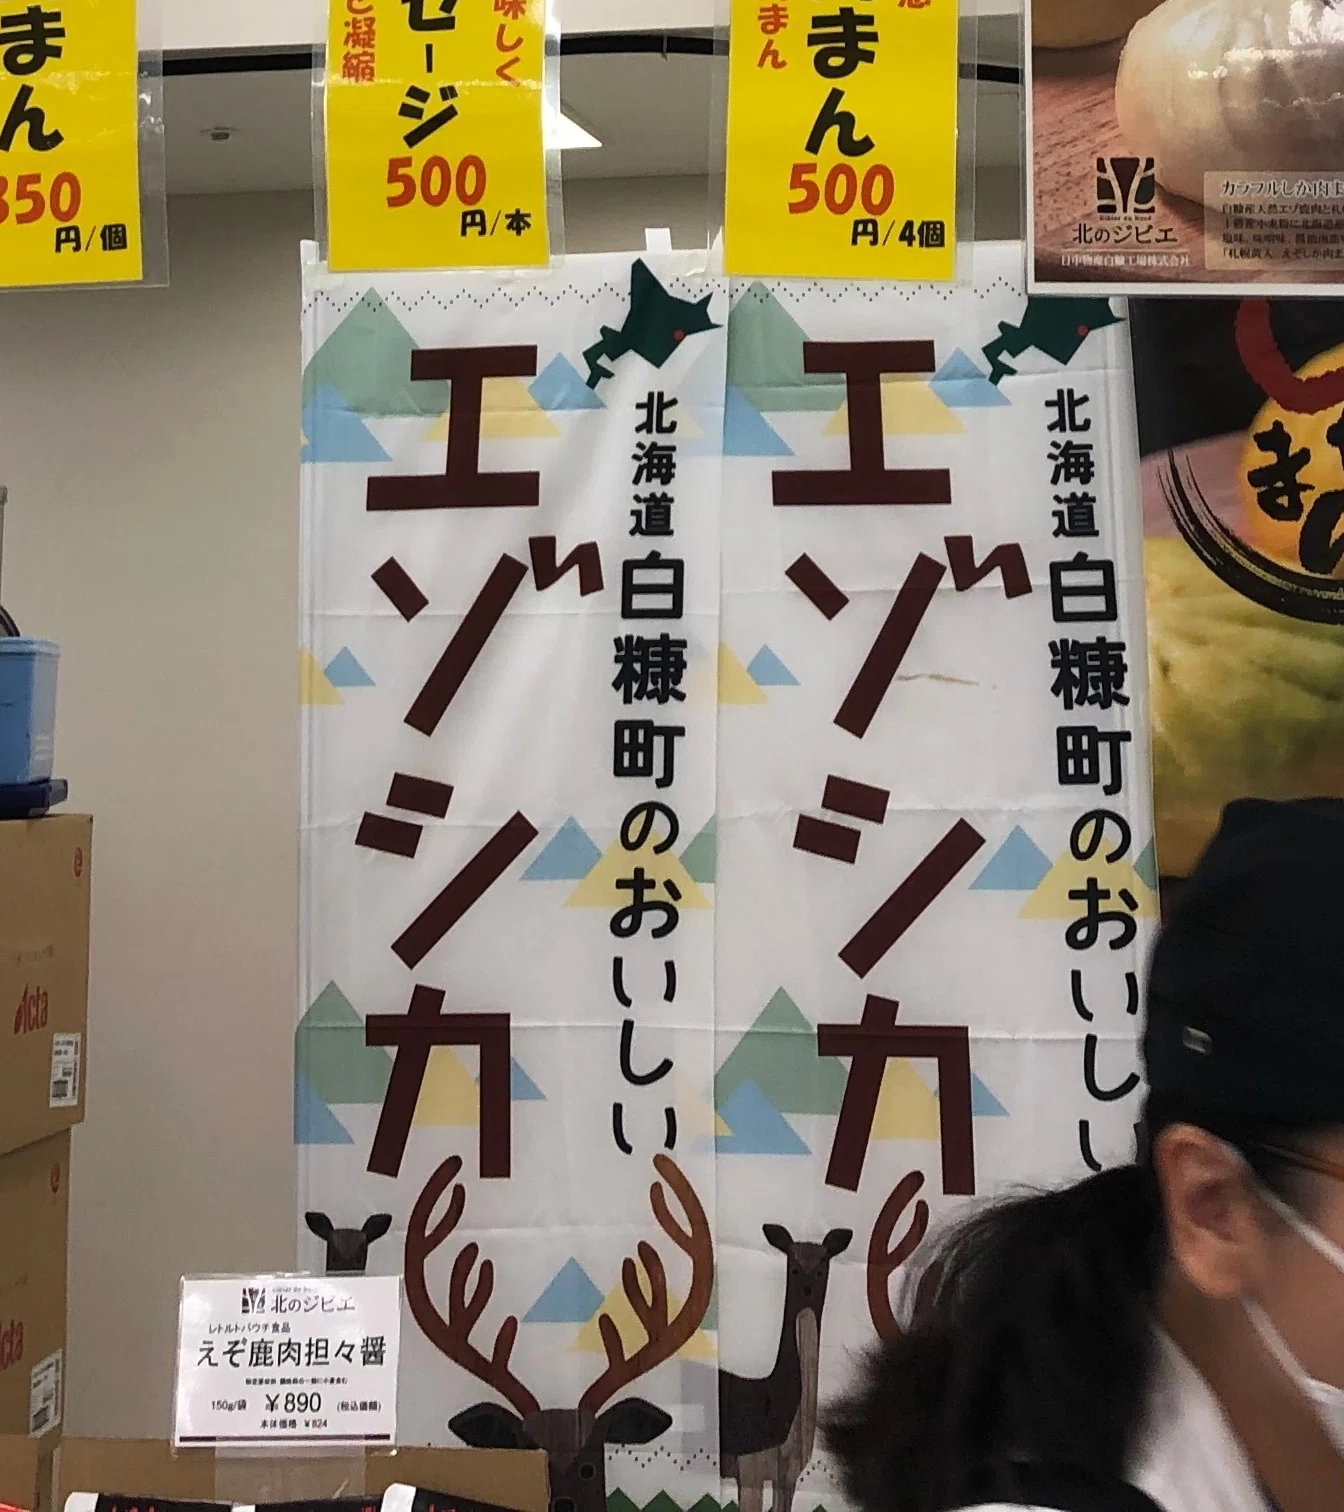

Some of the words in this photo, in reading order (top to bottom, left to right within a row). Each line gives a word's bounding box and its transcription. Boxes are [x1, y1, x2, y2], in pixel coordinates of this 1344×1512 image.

[385, 154, 487, 208] 500
[787, 161, 895, 216] 500
[54, 223, 129, 254] 円/個
[459, 207, 532, 238] 円/本
[850, 218, 945, 250] 円/4個
[1072, 222, 1179, 245] 北のジビエ
[355, 344, 605, 1179] エゾシカ
[609, 390, 687, 1155] 北海道白糠町のおいしい
[771, 340, 1033, 1196] エゾシカ
[270, 1293, 356, 1315] 北のジビエ
[208, 1322, 291, 1334] レトルトパウチ食品
[197, 1335, 387, 1368] えぞ鹿肉担々醤
